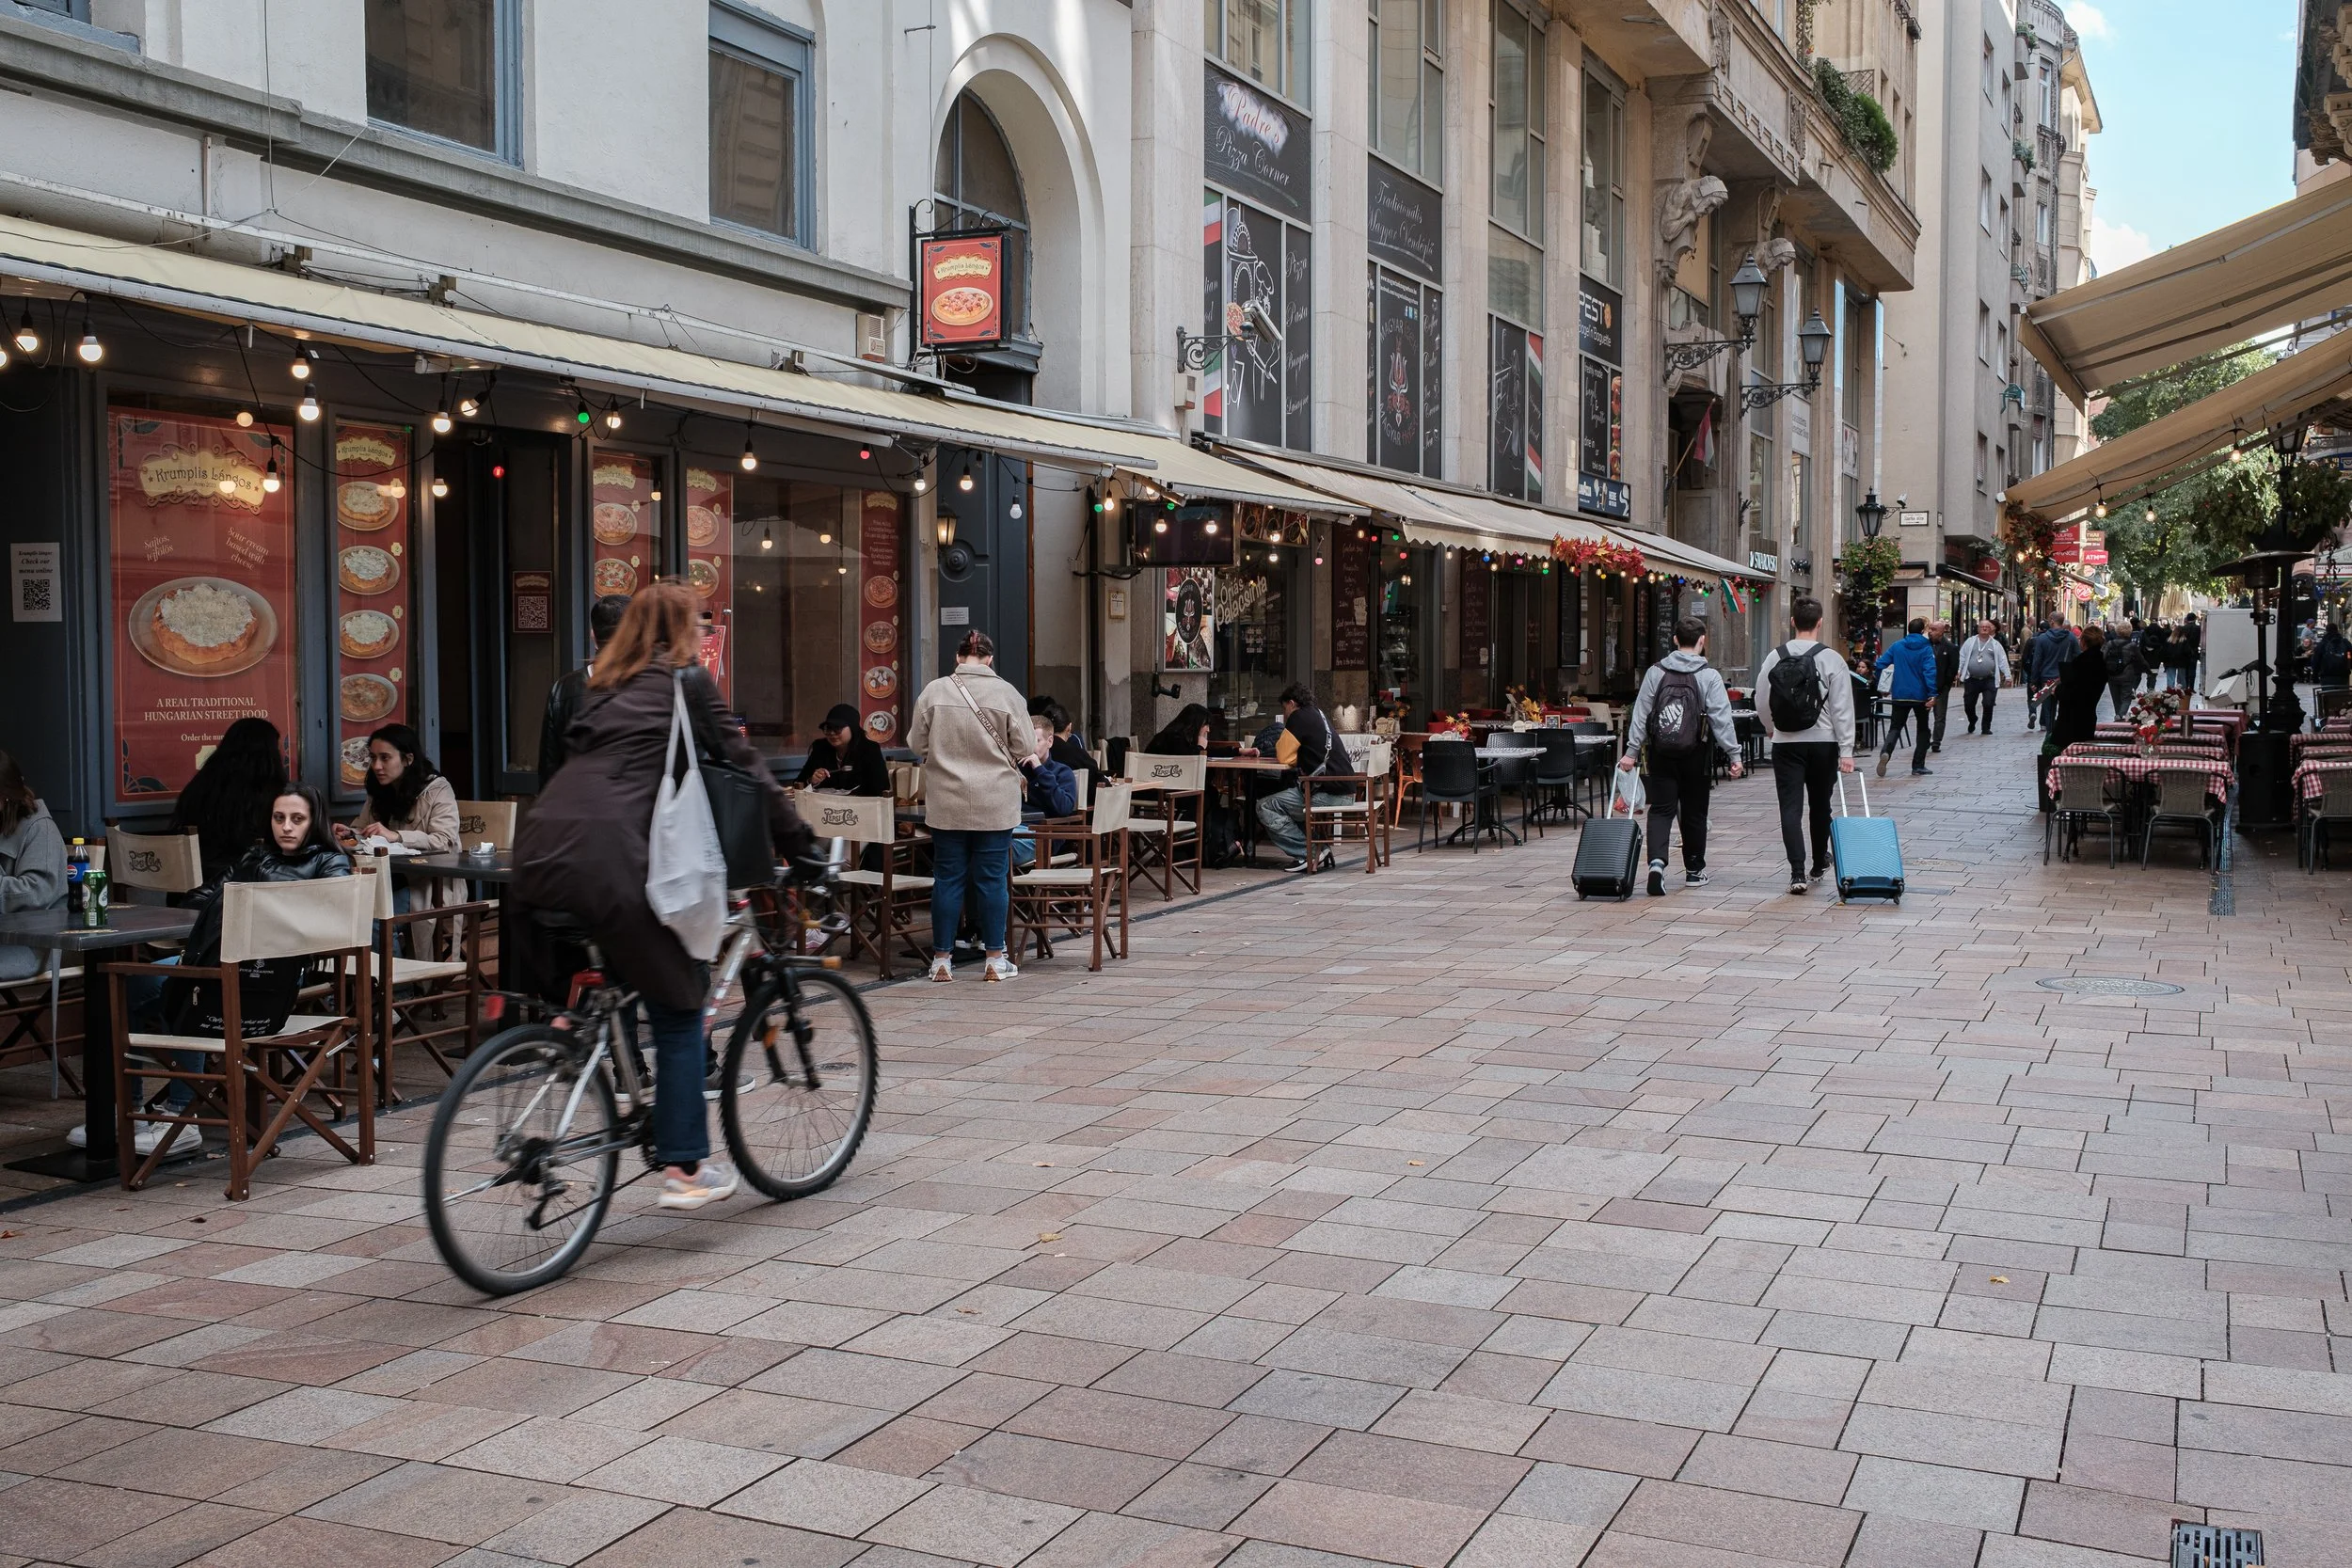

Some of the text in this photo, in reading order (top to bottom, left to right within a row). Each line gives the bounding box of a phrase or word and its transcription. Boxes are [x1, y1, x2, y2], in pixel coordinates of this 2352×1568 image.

[1216, 126, 1290, 186] Pizza Corner
[1286, 252, 1308, 282] Pizza
[156, 467, 251, 489] Krumplis Lángos
[144, 535, 169, 549] Sajtos,
[226, 537, 265, 564] based with
[228, 527, 269, 556] Sour cream
[230, 553, 255, 571] cheese
[156, 697, 257, 707] A REAL TRADITIONAL
[144, 709, 269, 721] HUNGARIAN STREET FOOD
[201, 733, 212, 741] the
[976, 710, 1005, 749] MICHAEL KORS
